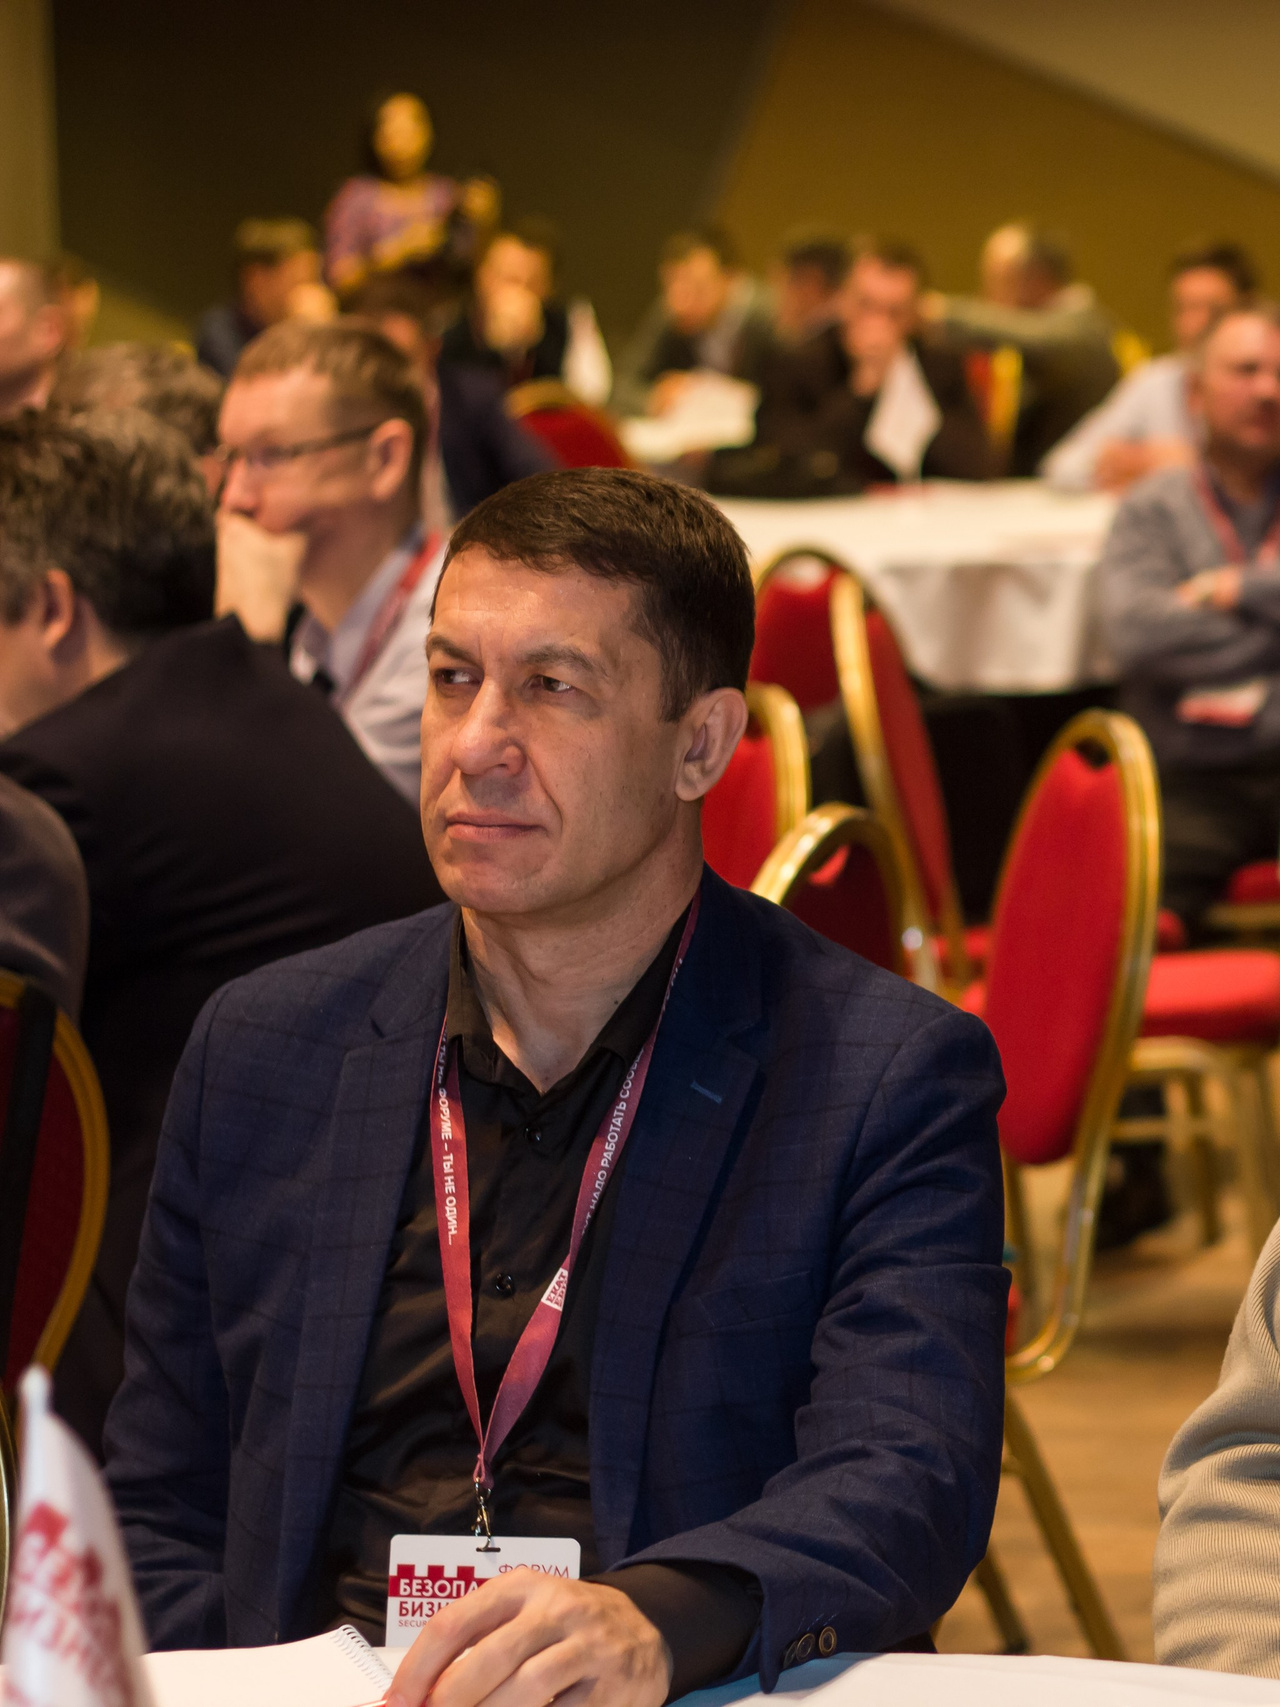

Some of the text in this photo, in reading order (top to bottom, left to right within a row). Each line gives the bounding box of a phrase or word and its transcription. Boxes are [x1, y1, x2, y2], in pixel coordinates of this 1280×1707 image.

[438, 1087, 452, 1140] ФОРУМЕ
[600, 1101, 627, 1168] РАБОТАТЬ
[442, 1152, 453, 1173] ТЫ
[444, 1175, 455, 1194] НЕ
[400, 1578, 479, 1597] БЕЗОПА
[398, 1619, 427, 1628] SECUR
